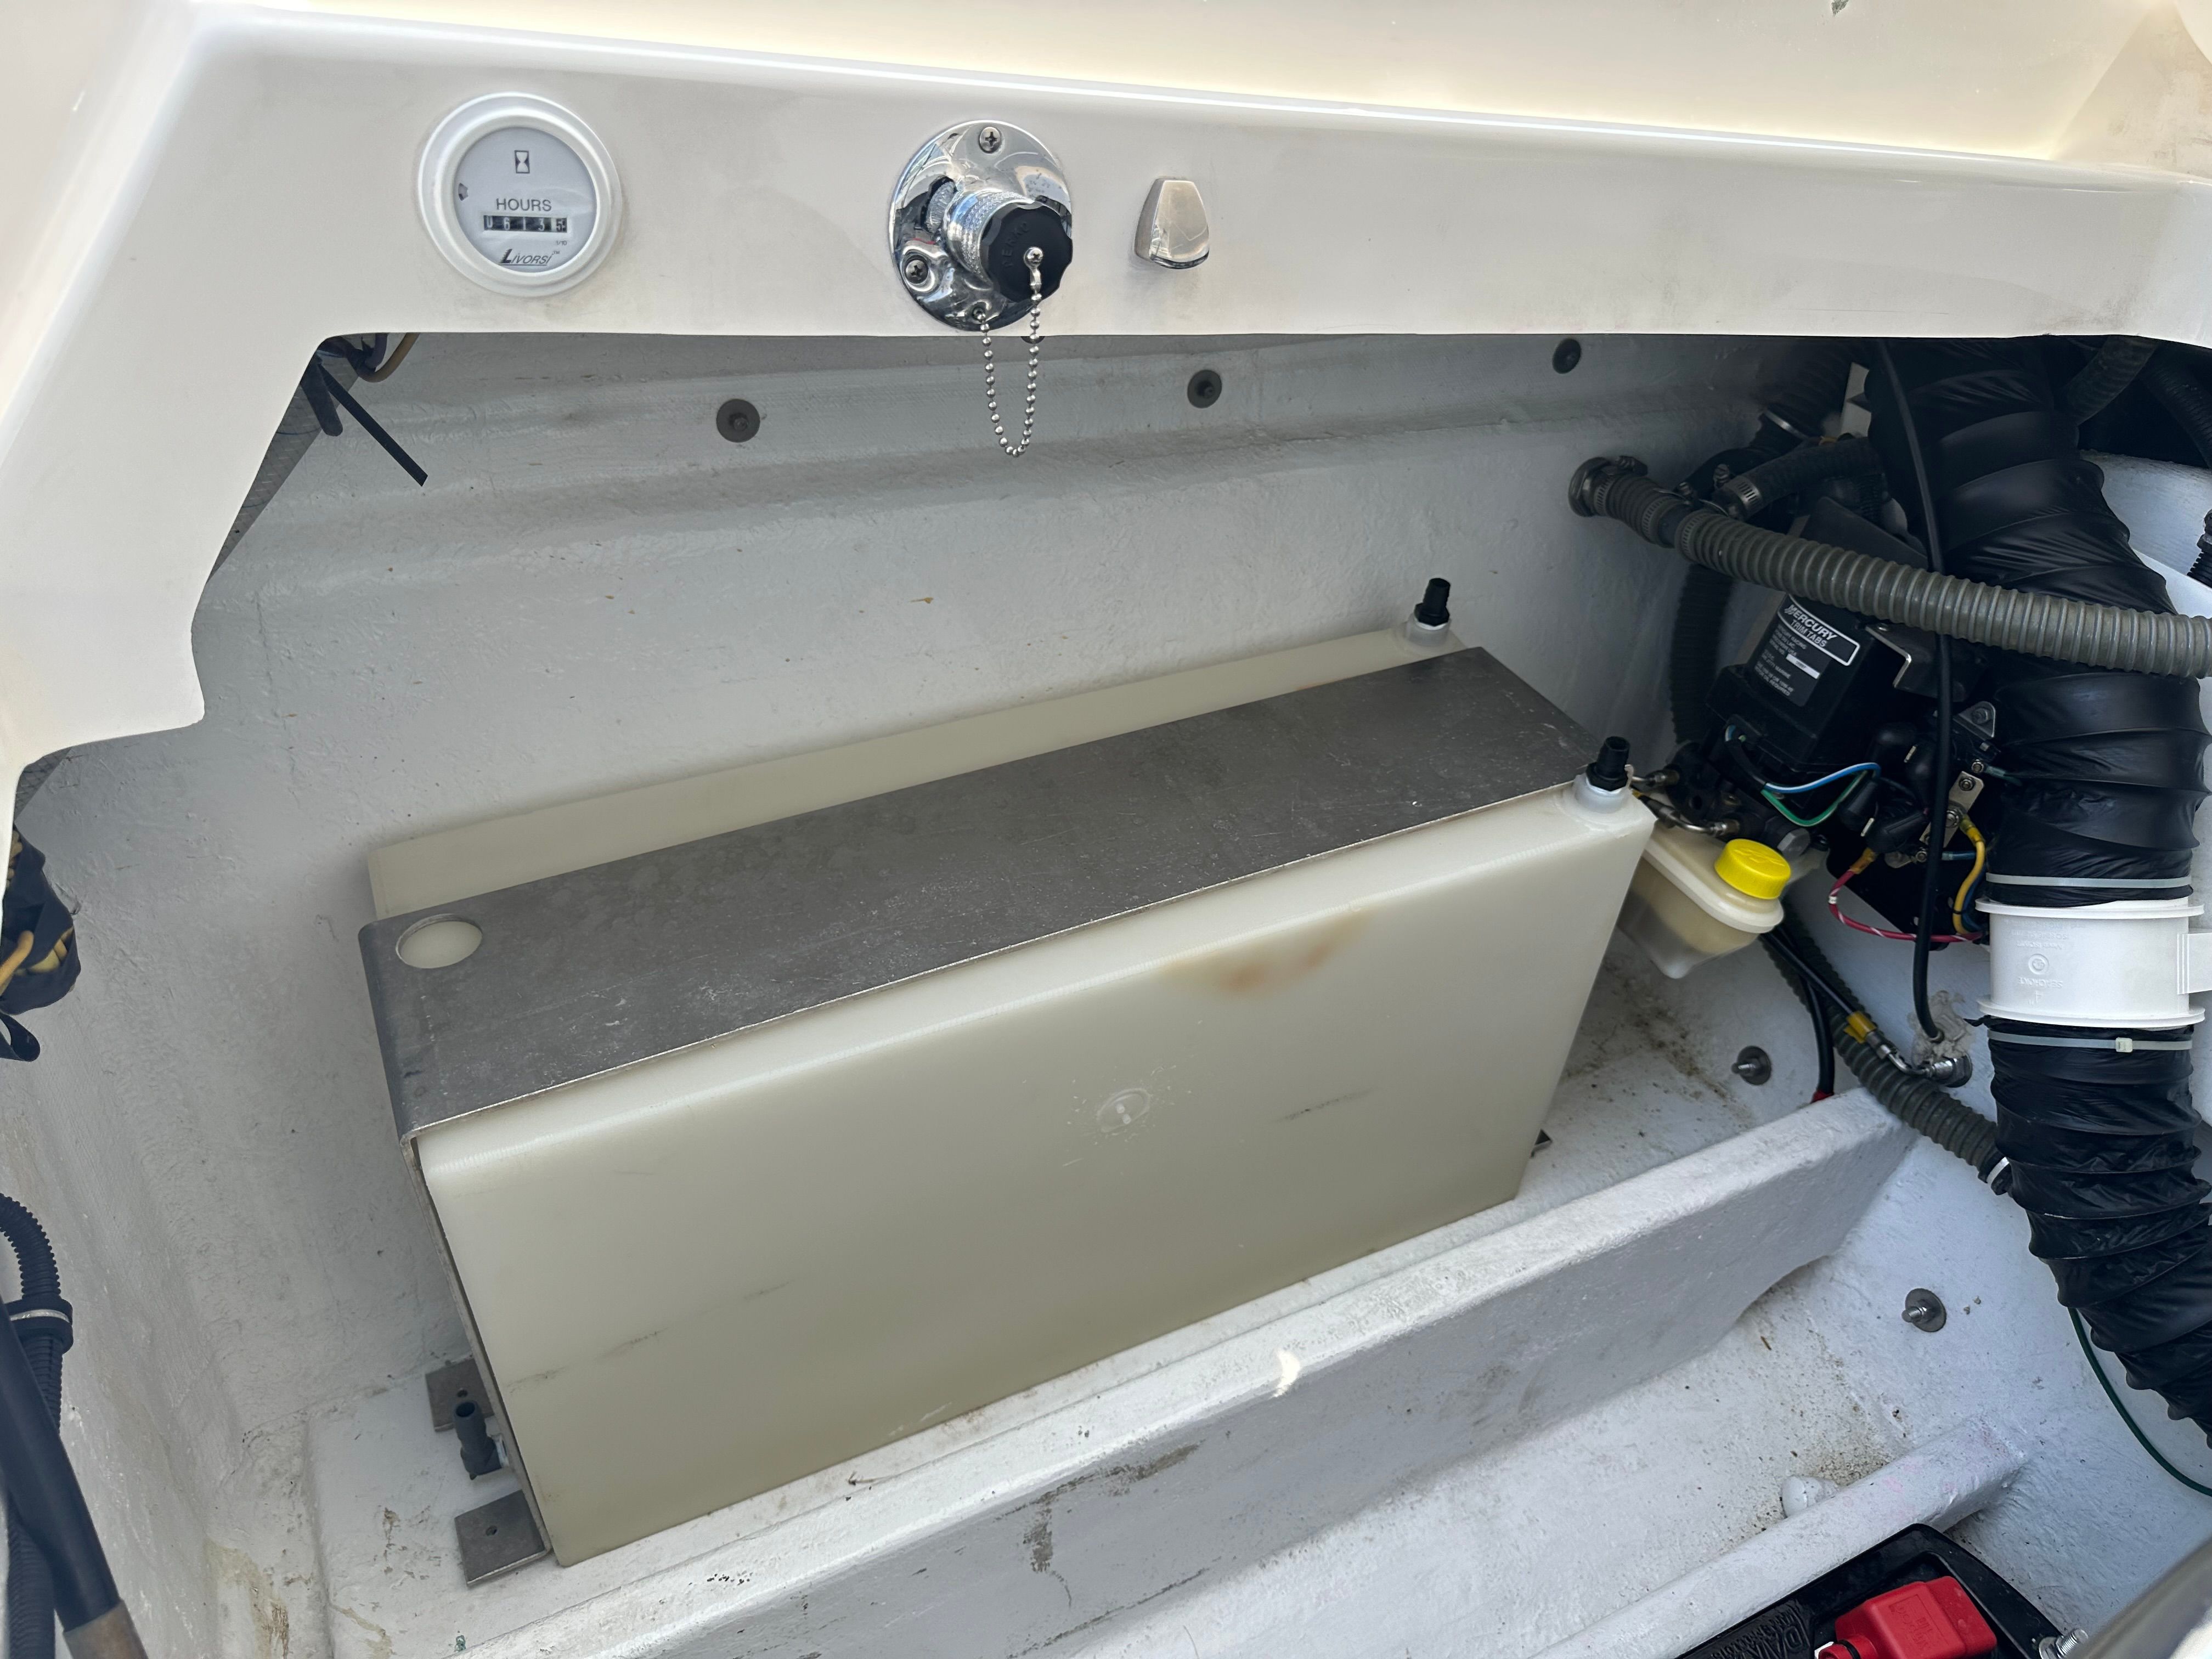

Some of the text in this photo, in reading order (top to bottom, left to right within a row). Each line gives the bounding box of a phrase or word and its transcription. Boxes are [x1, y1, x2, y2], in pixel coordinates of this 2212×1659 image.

[495, 198, 552, 212] HOURS
[1784, 604, 1838, 640] MERCURY
[1790, 619, 1827, 647] TRIM TABS
